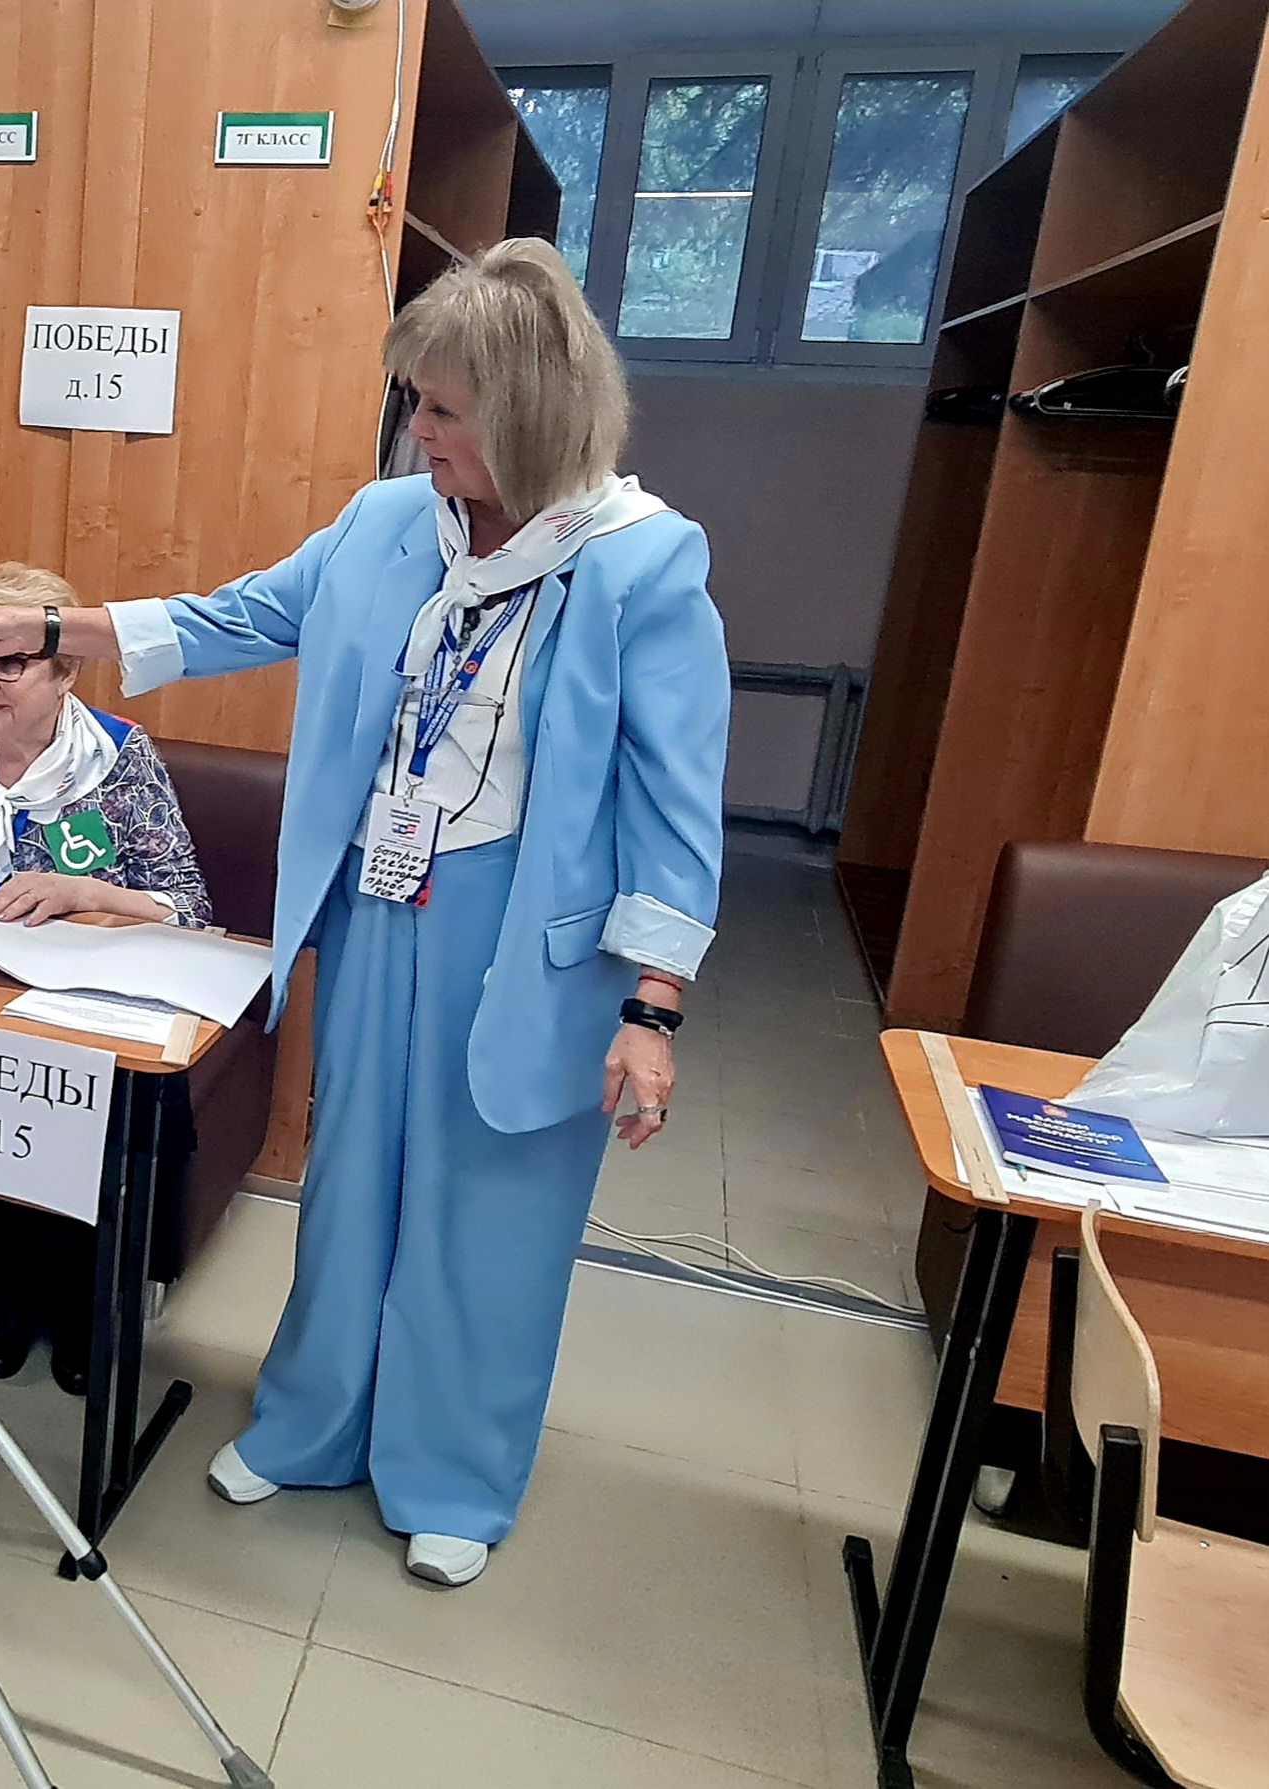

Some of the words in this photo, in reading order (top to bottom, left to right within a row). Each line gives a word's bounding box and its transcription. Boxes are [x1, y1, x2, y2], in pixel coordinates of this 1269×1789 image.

[236, 133, 252, 145] 7Г
[257, 132, 311, 146] КЛАСС
[32, 323, 171, 359] ПОБЕДЫ
[65, 372, 124, 401] д.15
